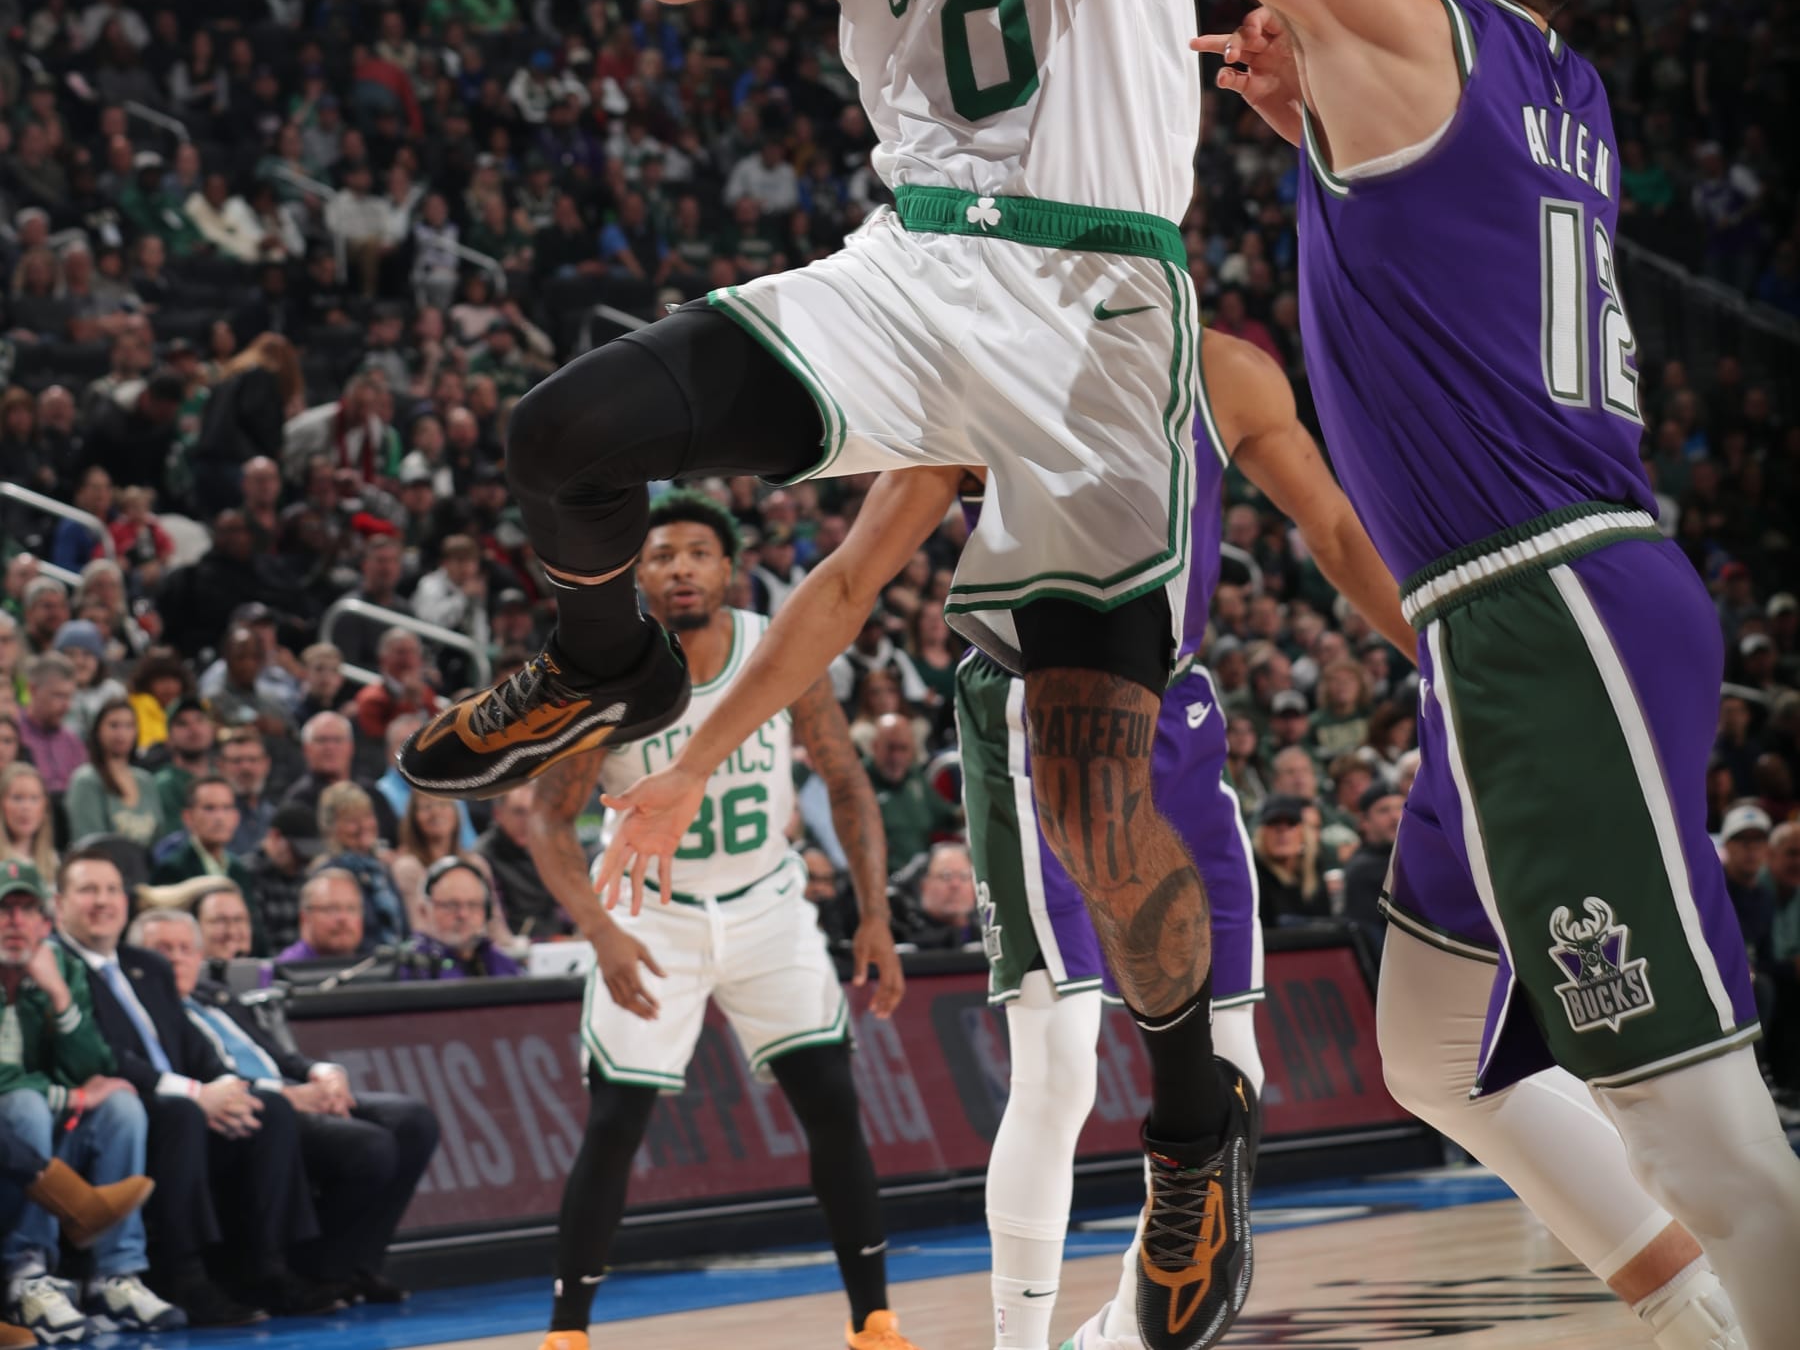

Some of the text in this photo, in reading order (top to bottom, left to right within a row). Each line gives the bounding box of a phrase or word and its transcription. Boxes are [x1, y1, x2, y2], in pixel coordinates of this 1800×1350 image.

[1521, 104, 1612, 200] ALLEN
[1540, 197, 1645, 426] 12
[1566, 969, 1646, 1024] BUCKS
